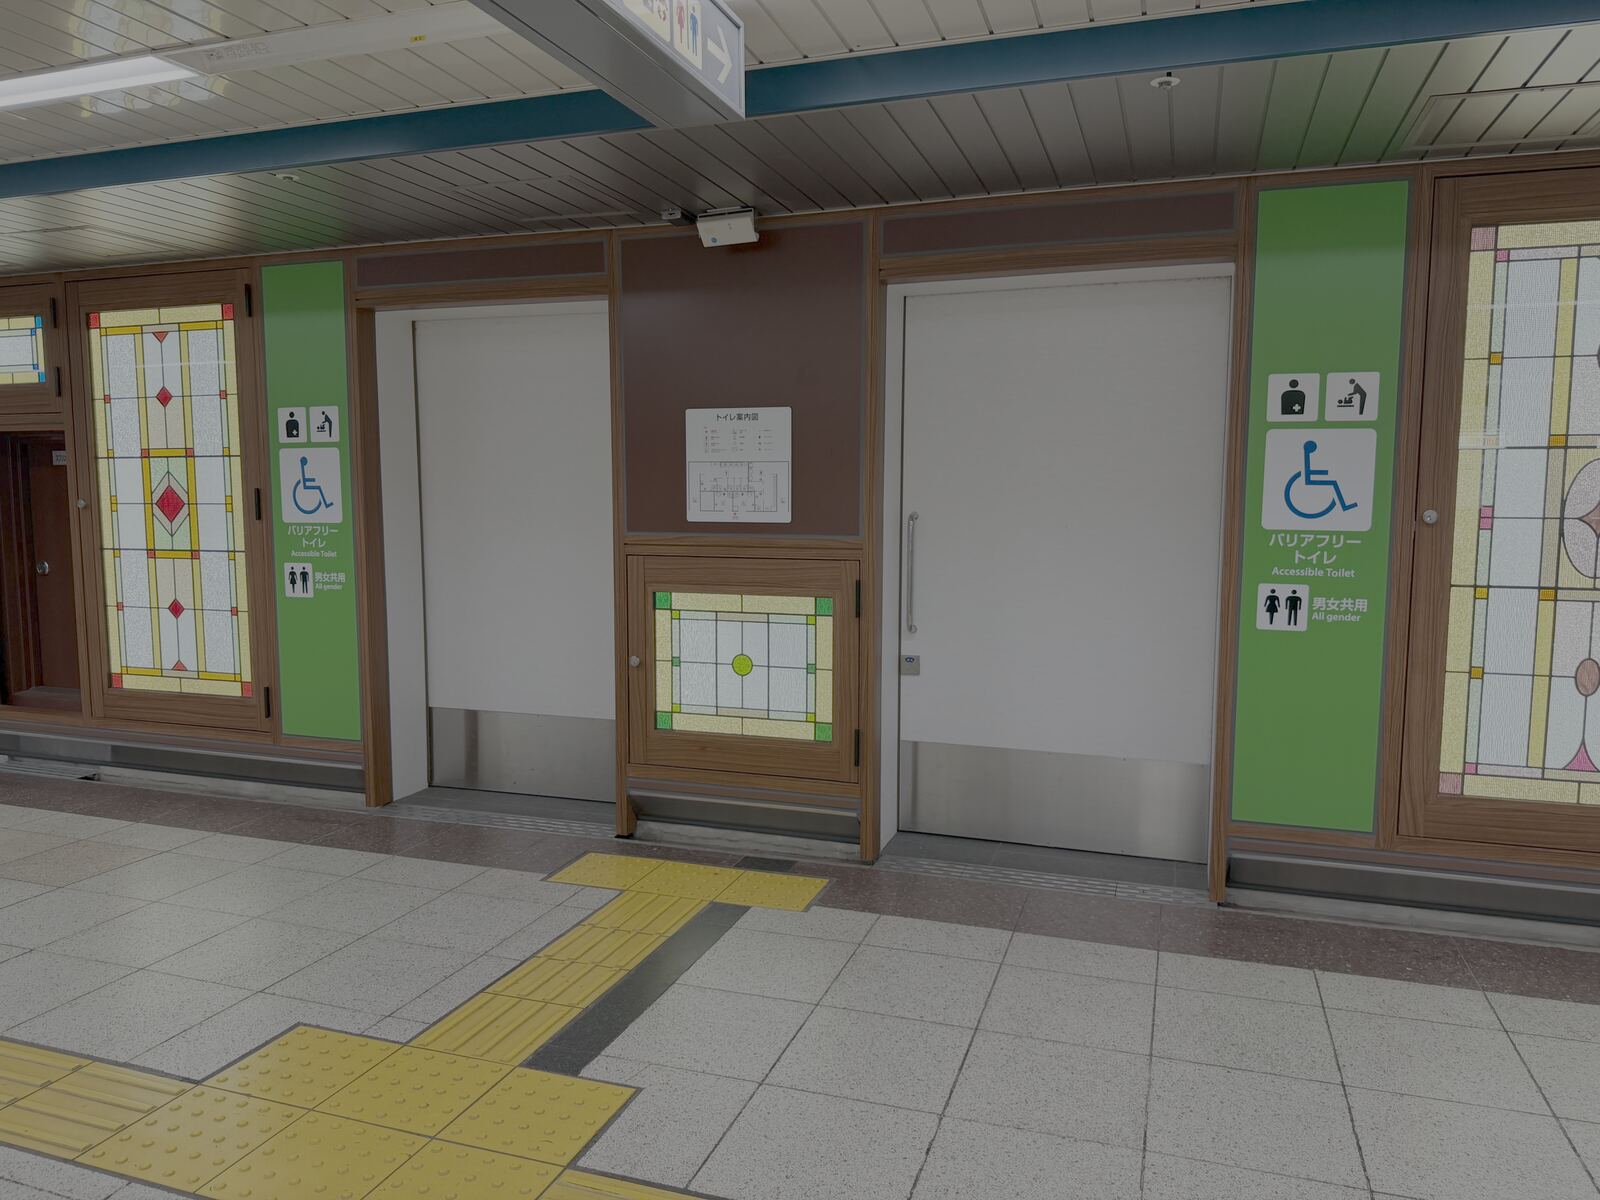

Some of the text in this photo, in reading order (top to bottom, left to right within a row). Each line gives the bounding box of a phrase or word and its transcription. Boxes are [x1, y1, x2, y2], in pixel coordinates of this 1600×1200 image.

[716, 413, 759, 422] トイレ案内図
[287, 525, 339, 536] バリアフリー
[302, 537, 327, 548] トイレ
[1269, 533, 1362, 548] バリアフリー
[290, 550, 337, 558] Accessible Toilet
[1295, 550, 1337, 565] トイレ
[315, 572, 346, 583] 男女共用
[1272, 566, 1356, 578] Accessible Toilet
[324, 584, 343, 592] gender
[1312, 597, 1368, 613] 男女共用
[1312, 612, 1361, 623] All gender
